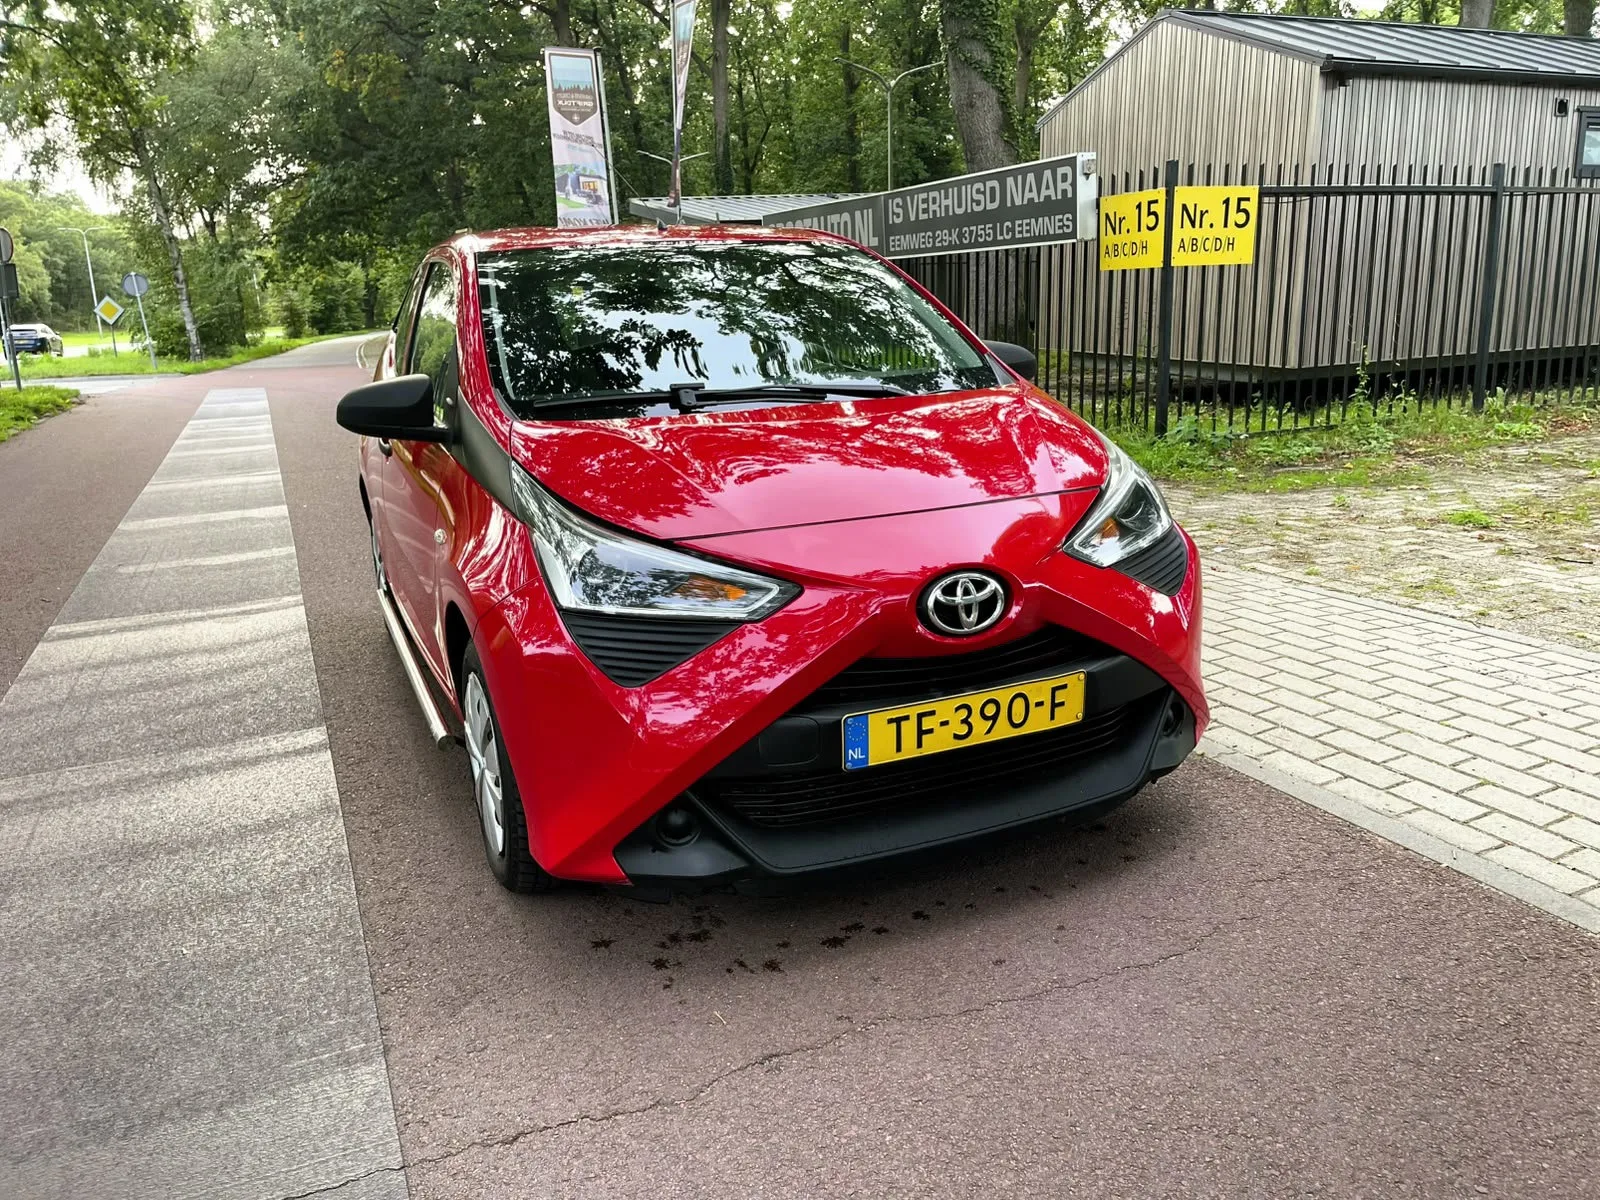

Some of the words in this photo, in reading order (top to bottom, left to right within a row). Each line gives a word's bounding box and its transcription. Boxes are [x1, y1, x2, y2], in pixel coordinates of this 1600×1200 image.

[888, 197, 904, 225] IS
[907, 179, 1000, 222] VERHUISD
[1006, 165, 1073, 207] NAAR
[1179, 202, 1214, 229] Nr.
[1222, 196, 1251, 229] 15
[889, 231, 933, 252] EEMWEG
[935, 228, 960, 248] 29-K
[962, 224, 994, 245] 3755
[996, 221, 1012, 241] LC
[1015, 213, 1073, 239] EEMNES
[1104, 211, 1131, 237] Nr.
[1135, 199, 1160, 233] 15
[1104, 240, 1148, 260] A/B/C/D/H
[1177, 235, 1235, 255] A/B/C/D/H
[886, 683, 1069, 754] TF-390-F
[848, 747, 866, 761] NL
